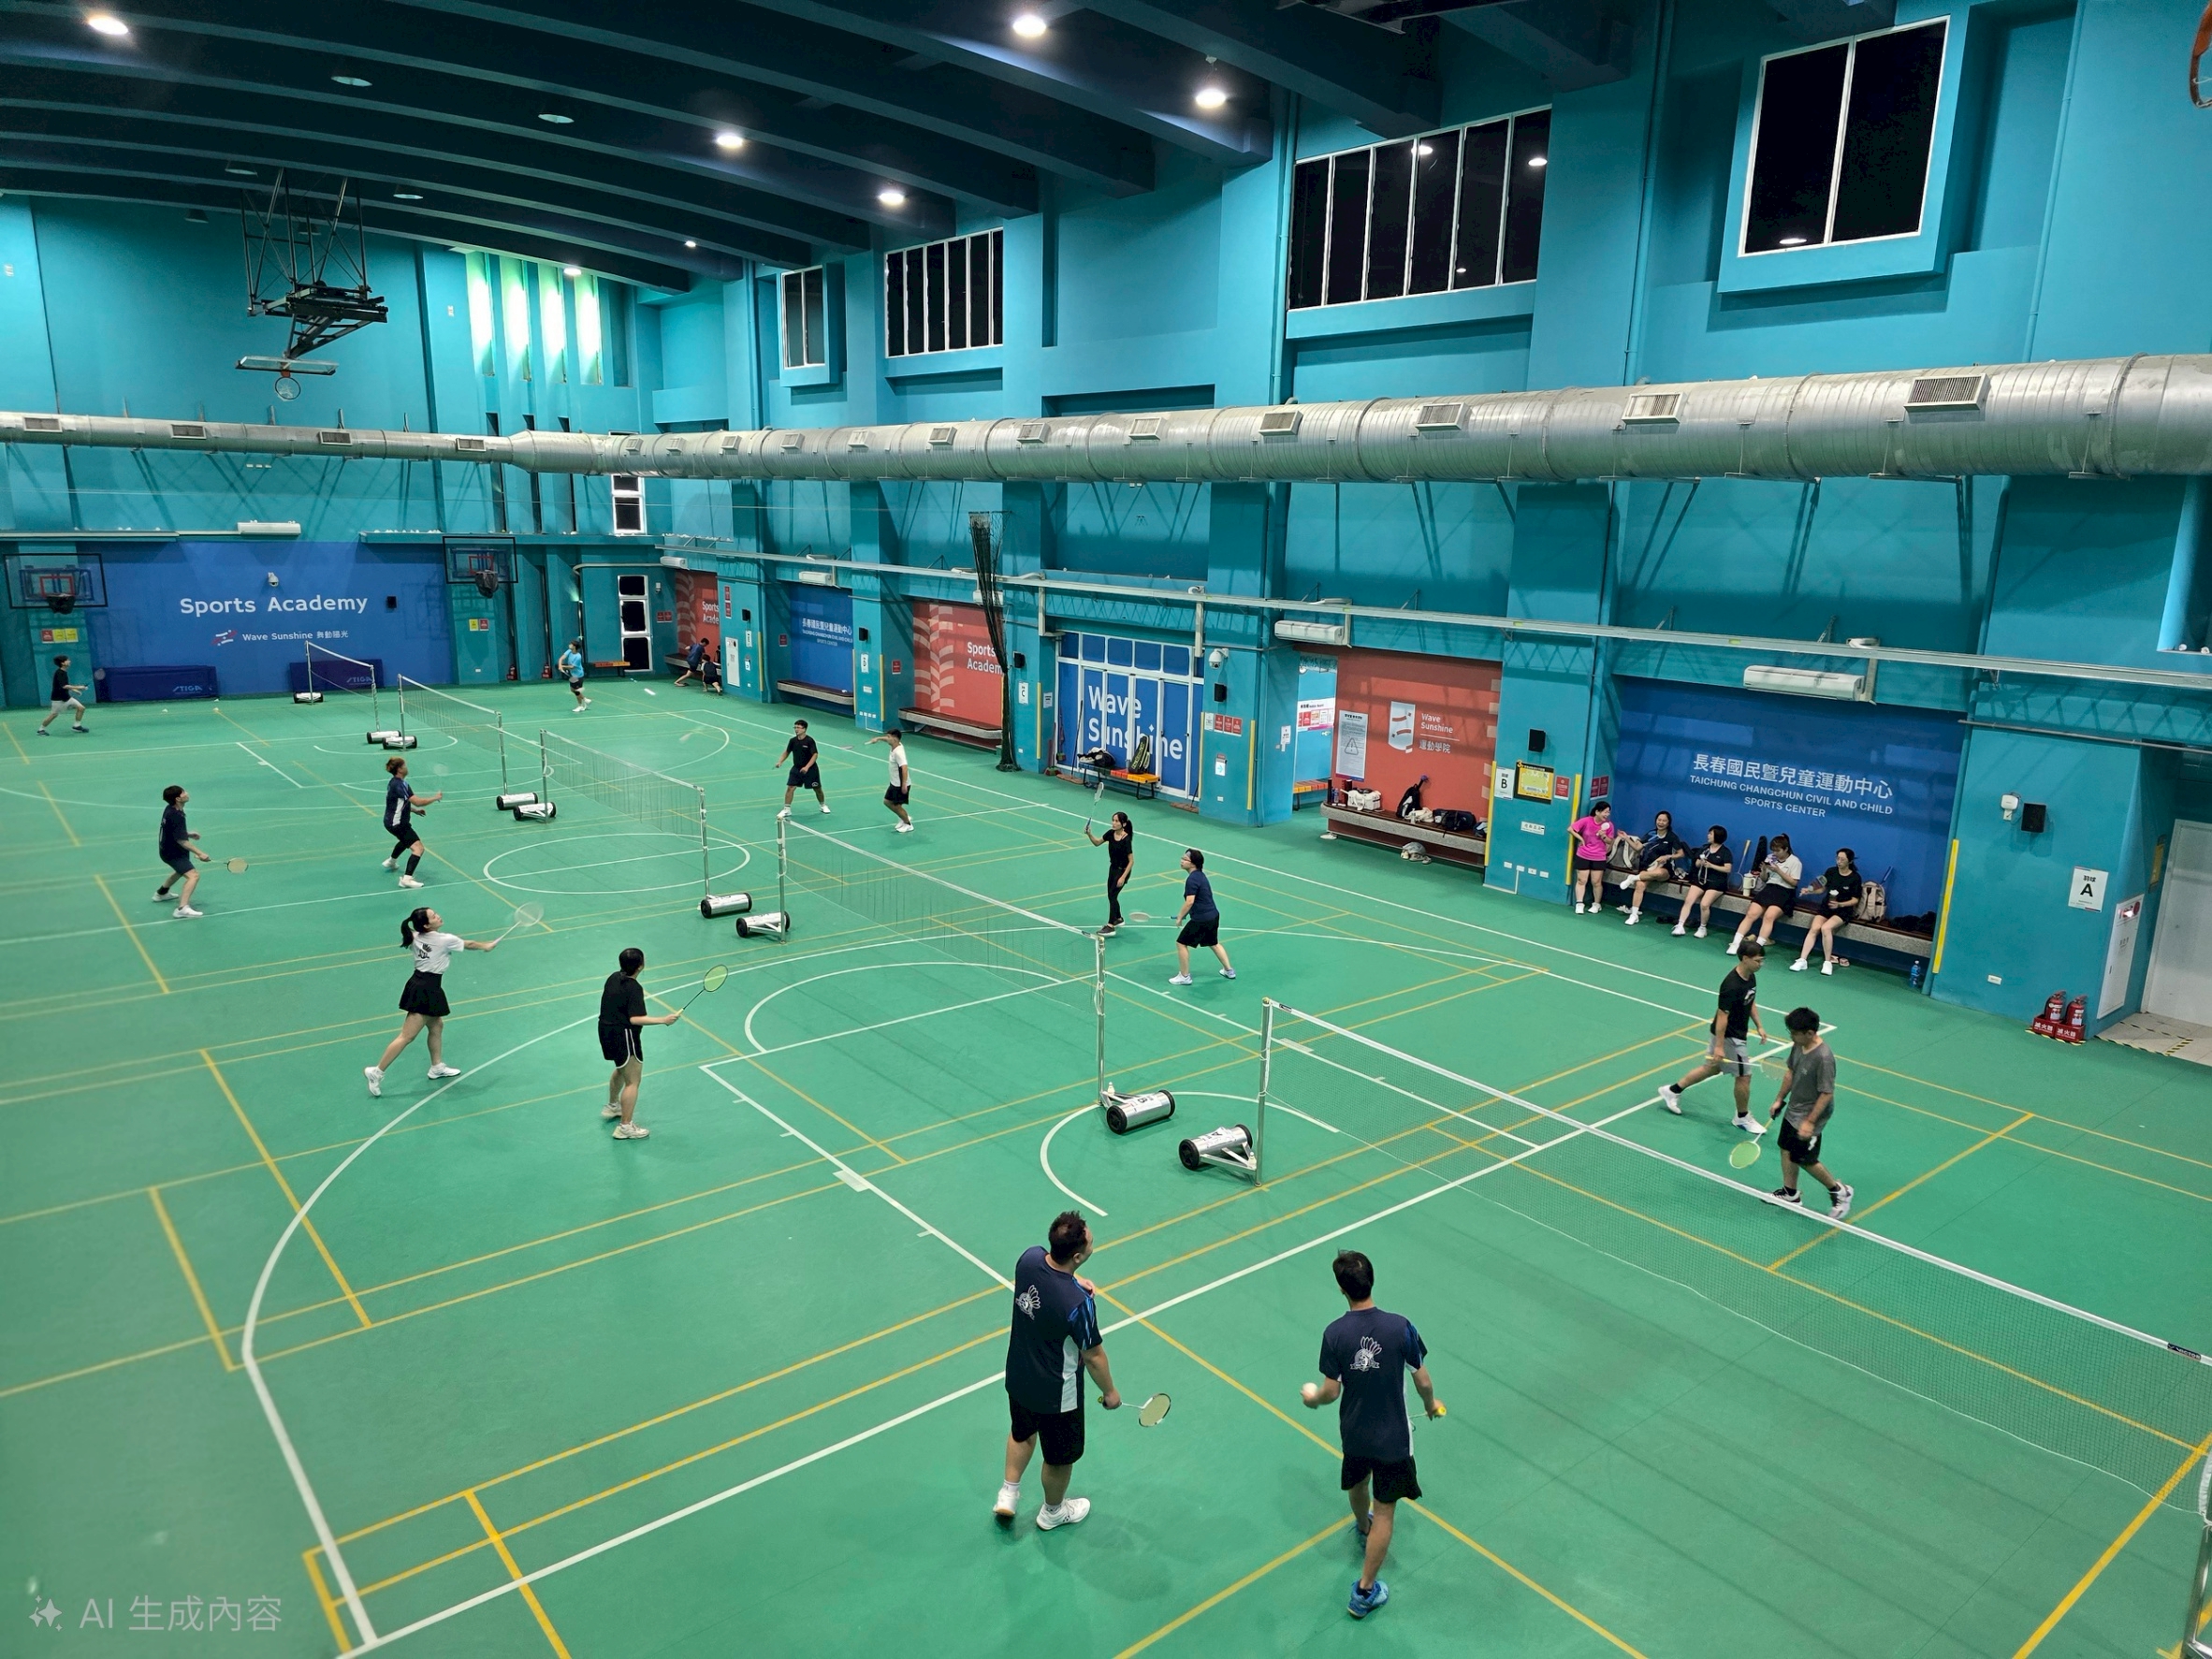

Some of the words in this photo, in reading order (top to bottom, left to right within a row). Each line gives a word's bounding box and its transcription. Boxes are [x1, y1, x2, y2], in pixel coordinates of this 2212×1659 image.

[180, 597, 256, 618] Sports
[268, 594, 369, 614] Academy
[702, 601, 720, 612] Sports
[241, 633, 269, 641] Wave
[271, 632, 313, 640] Sunshine
[967, 641, 996, 657] Sports
[1088, 685, 1142, 719] Wave
[1421, 713, 1441, 723] Wave
[1420, 721, 1454, 734] Sunshine
[1501, 779, 1507, 789] B
[1693, 753, 1893, 800] 長春國民暨兒童運動中心
[1690, 775, 1738, 791] TAICHUNG
[1739, 783, 1803, 801] CHANGCHUN
[1805, 793, 1832, 806] CIVIL
[1834, 798, 1857, 809] AND
[1859, 802, 1893, 815] CHILD
[1744, 796, 1783, 810] SPORTS
[1784, 803, 1826, 818] CENTER
[2080, 883, 2093, 897] A
